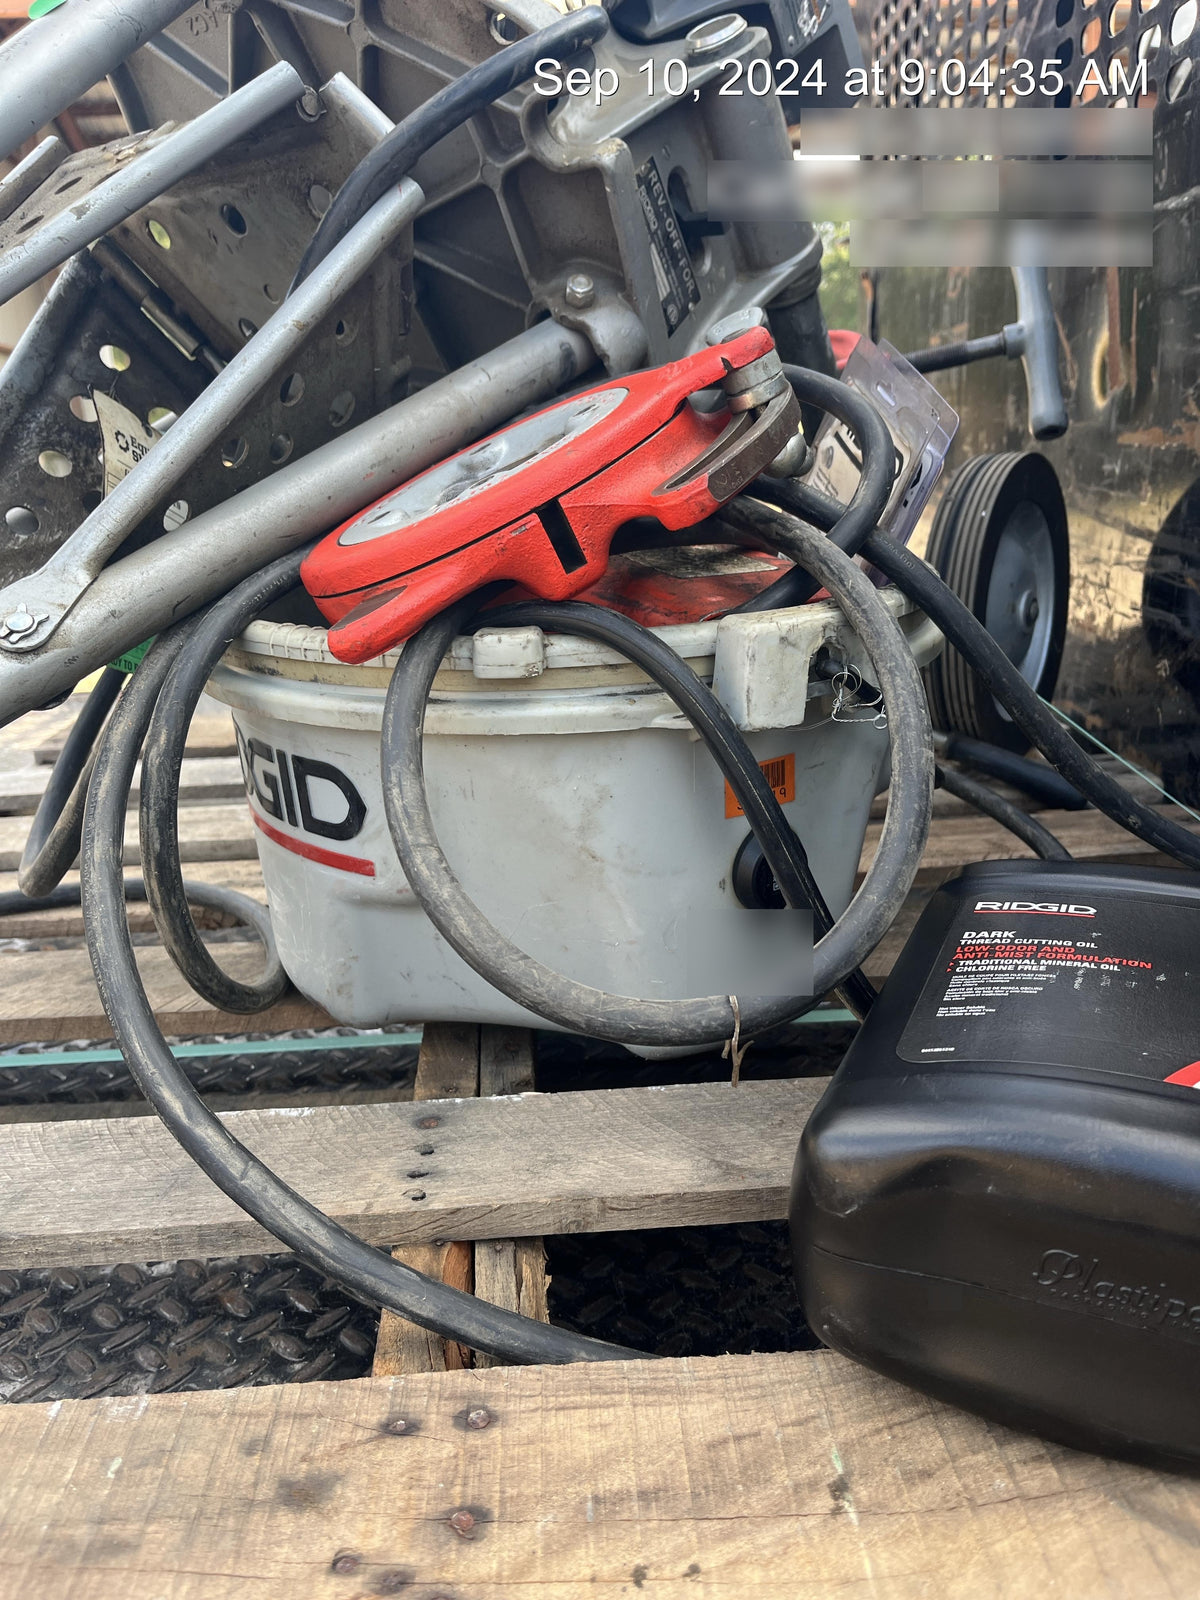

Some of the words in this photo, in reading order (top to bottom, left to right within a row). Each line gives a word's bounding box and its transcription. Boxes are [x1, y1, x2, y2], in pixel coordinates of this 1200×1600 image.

[123, 660, 132, 671] TO
[974, 901, 1098, 915] RIDGID
[962, 930, 1017, 939] DARK
[1014, 938, 1073, 946] CUTTING
[956, 945, 1037, 953] LOW-ODOR
[952, 951, 1035, 960] ANTI-MIST
[1037, 951, 1152, 969] FORMULATION
[1039, 959, 1098, 969] MINERAL
[1101, 963, 1121, 971] OIL
[955, 965, 1015, 973] CHLORINE
